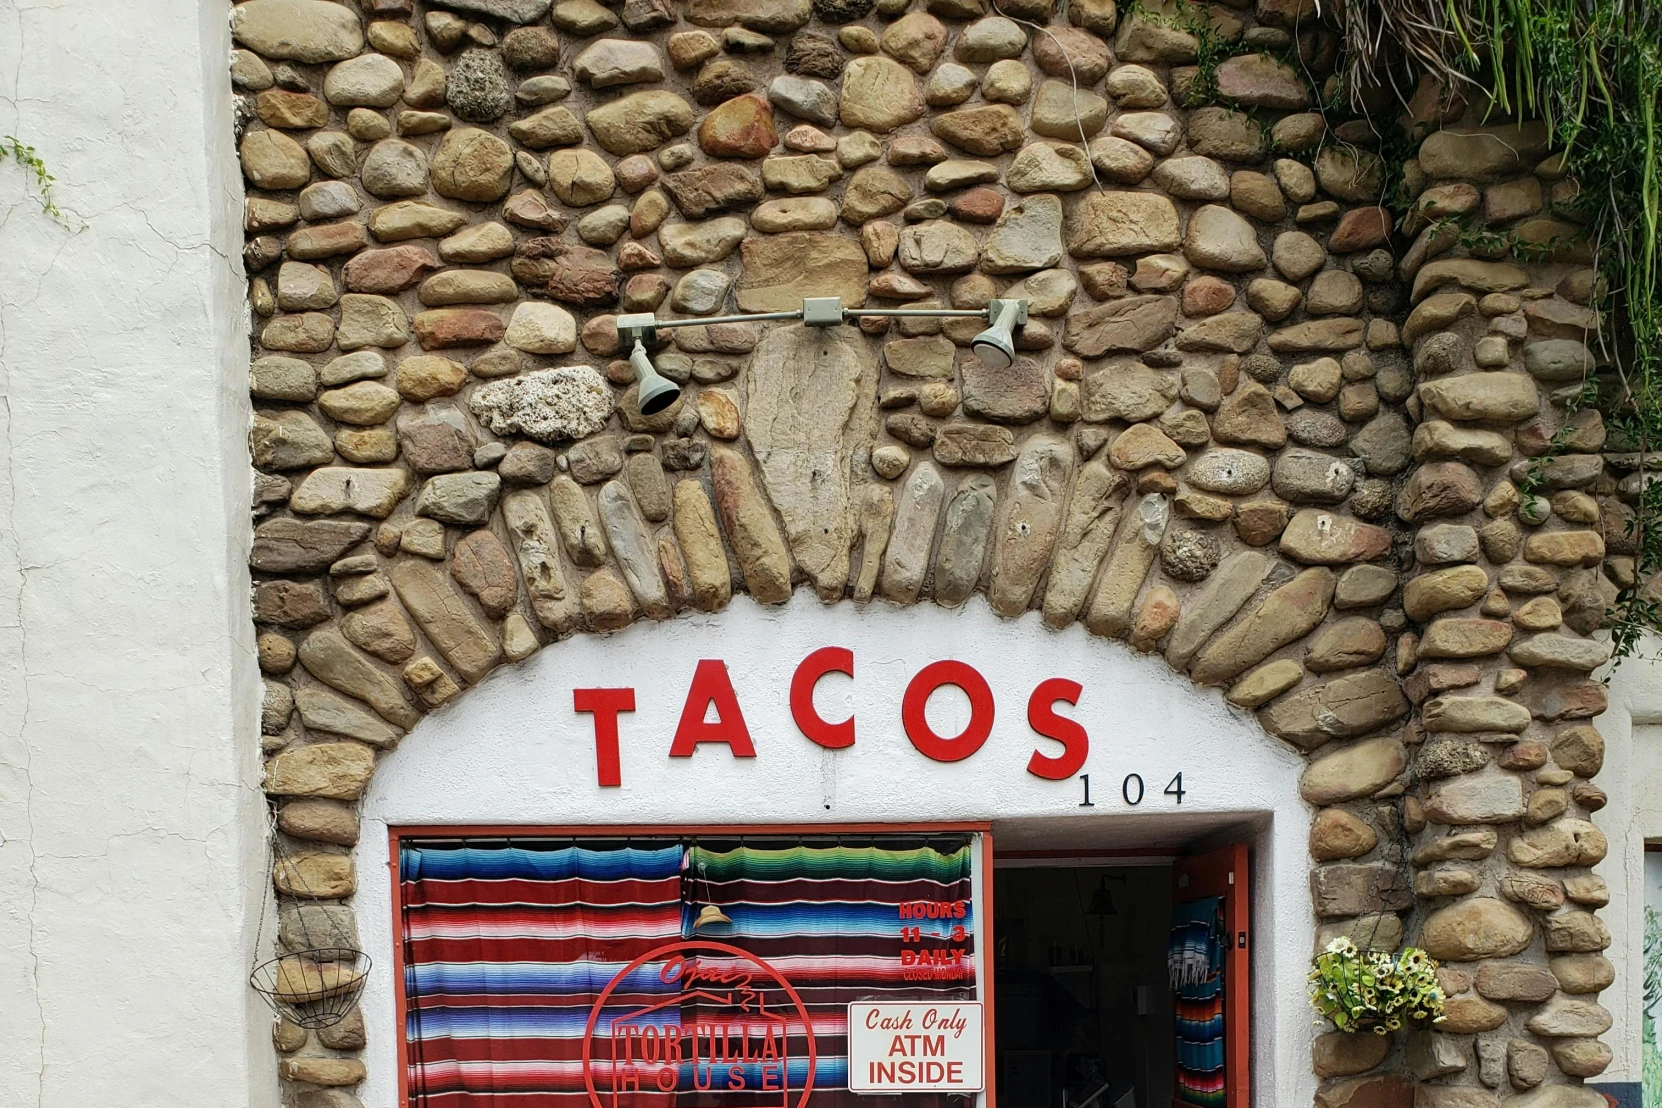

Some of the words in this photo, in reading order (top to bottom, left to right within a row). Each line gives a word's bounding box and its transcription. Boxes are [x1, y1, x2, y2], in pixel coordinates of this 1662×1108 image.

[573, 645, 1089, 787] TACOS
[1077, 771, 1187, 807] 104
[899, 901, 966, 919] HOURS
[900, 926, 920, 943] 11
[952, 925, 966, 942] 3
[901, 948, 966, 966] DAILY
[904, 968, 933, 981] CLOSED
[865, 1008, 914, 1030] Cash
[922, 1008, 968, 1039] Only
[617, 1024, 780, 1066] TORTILLA
[888, 1034, 945, 1056] ATM
[621, 1065, 780, 1092] HOUSE
[869, 1061, 964, 1084] INSIDE
